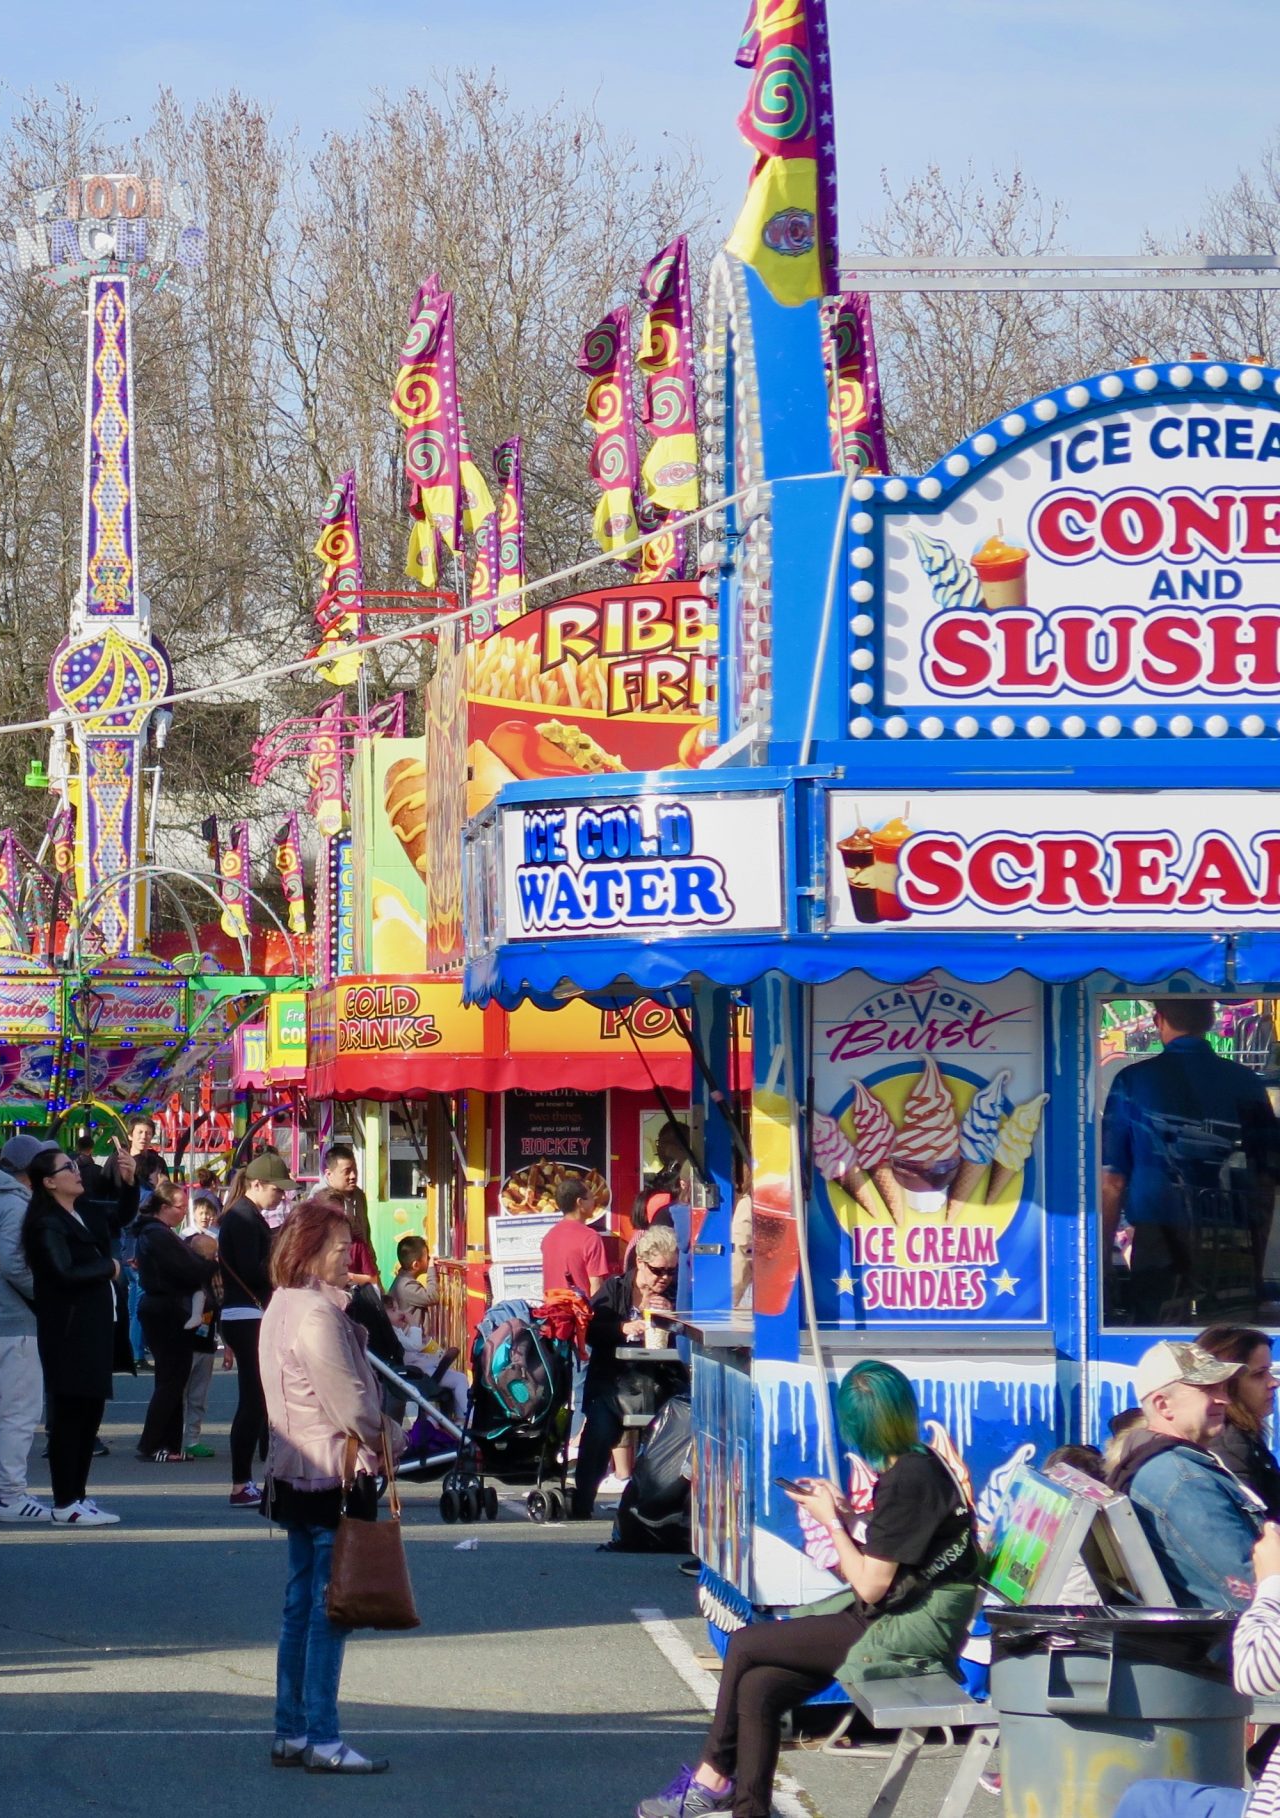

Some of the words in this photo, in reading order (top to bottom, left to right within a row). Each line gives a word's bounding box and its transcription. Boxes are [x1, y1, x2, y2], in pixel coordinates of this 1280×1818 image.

[67, 175, 164, 219] 1001
[15, 217, 209, 269] NACHTS
[1050, 422, 1131, 482] ICE
[1038, 496, 1280, 557] CONE
[1149, 569, 1243, 600] AND
[931, 616, 1280, 687] SLUSH
[523, 809, 568, 864] ICE
[576, 803, 694, 862] COLD
[518, 866, 725, 922] WATER
[906, 838, 1280, 906] SCREA
[344, 985, 421, 1018] COLD
[863, 990, 974, 1027] FLAVOR
[339, 1015, 443, 1051] DRINKS
[826, 1008, 1034, 1063] Burst
[520, 1137, 592, 1156] HOCKEY
[853, 1226, 896, 1265] ICE
[906, 1226, 998, 1265] CREAM
[865, 1270, 987, 1308] SUNDAES
